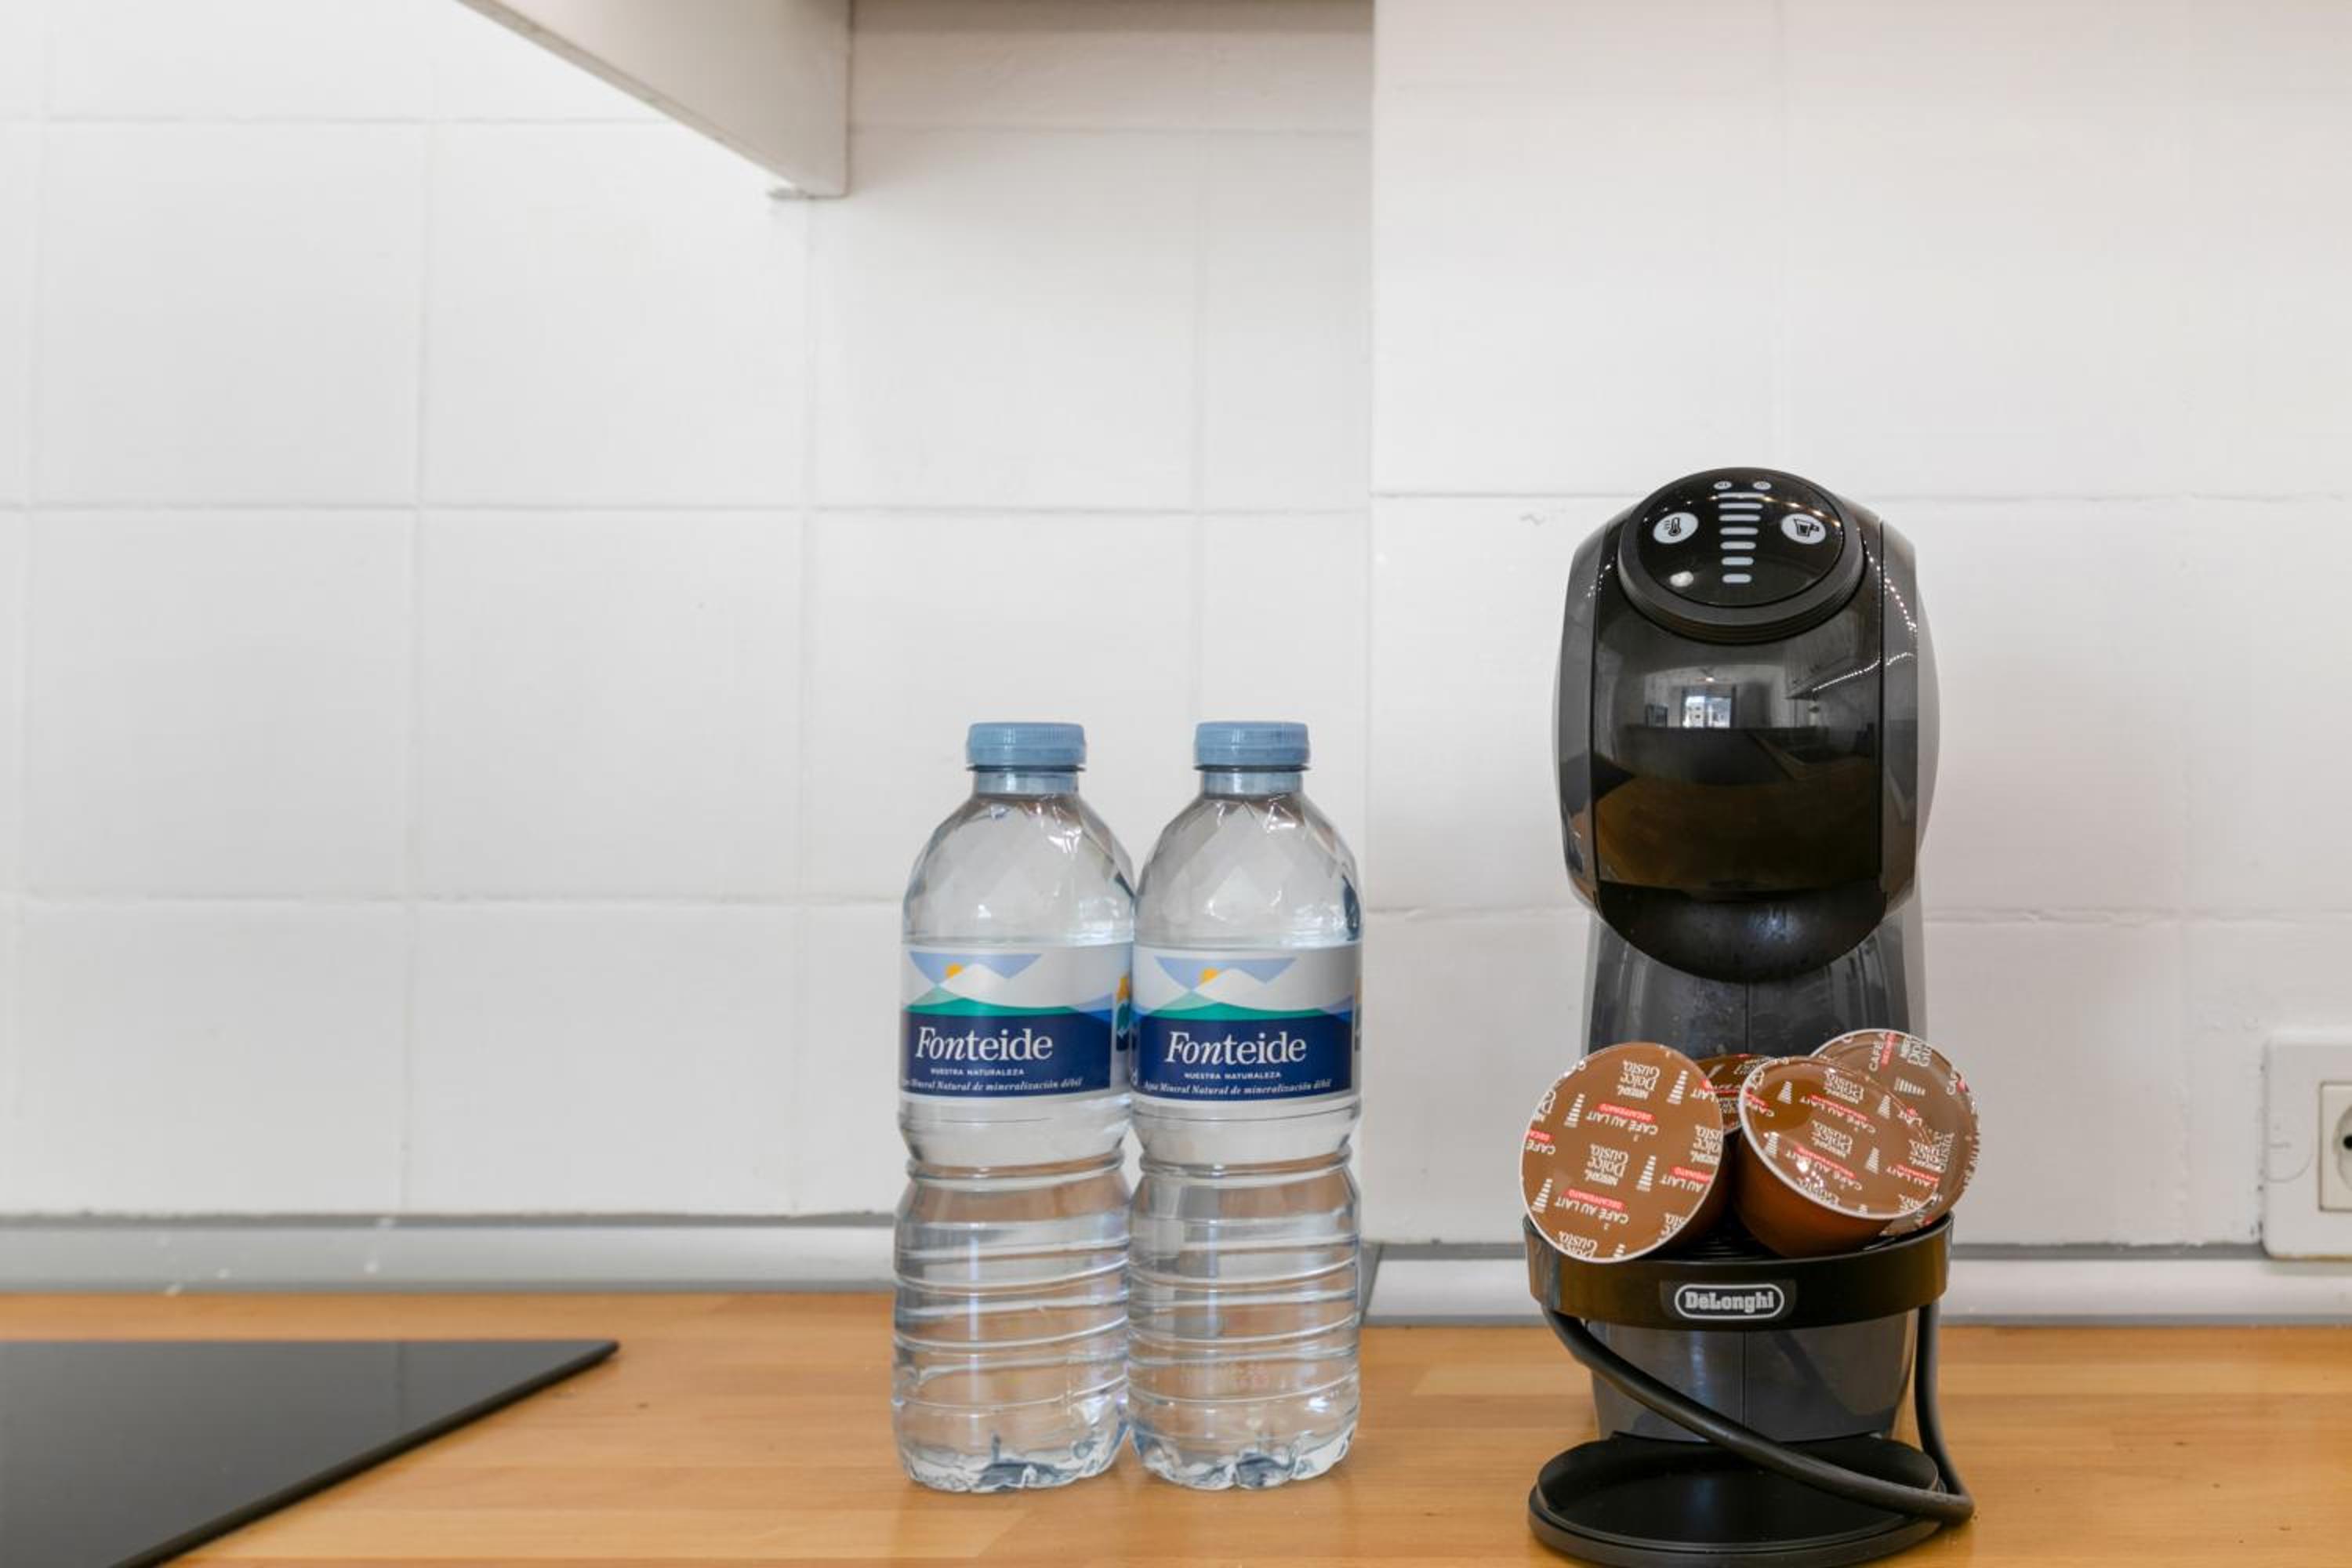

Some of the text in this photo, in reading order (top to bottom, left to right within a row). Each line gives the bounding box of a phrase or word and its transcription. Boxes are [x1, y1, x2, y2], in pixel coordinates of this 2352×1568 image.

[915, 1026, 1054, 1062] Fonteide
[1164, 1031, 1307, 1065] Fonteide
[967, 1068, 1025, 1076] NATURALEZA
[937, 1081, 967, 1091] Natural
[969, 1082, 983, 1091] de
[1191, 1084, 1229, 1095] Natural
[1230, 1085, 1243, 1095] de
[1586, 1111, 1610, 1125] LAIT
[1828, 1107, 1845, 1118] AU
[1610, 1115, 1628, 1127] AU
[1660, 1174, 1705, 1192] AU LAIT
[1555, 1196, 1580, 1212] LAIT
[1580, 1203, 1598, 1216] AU
[1684, 1291, 1774, 1314] DeLonghi
